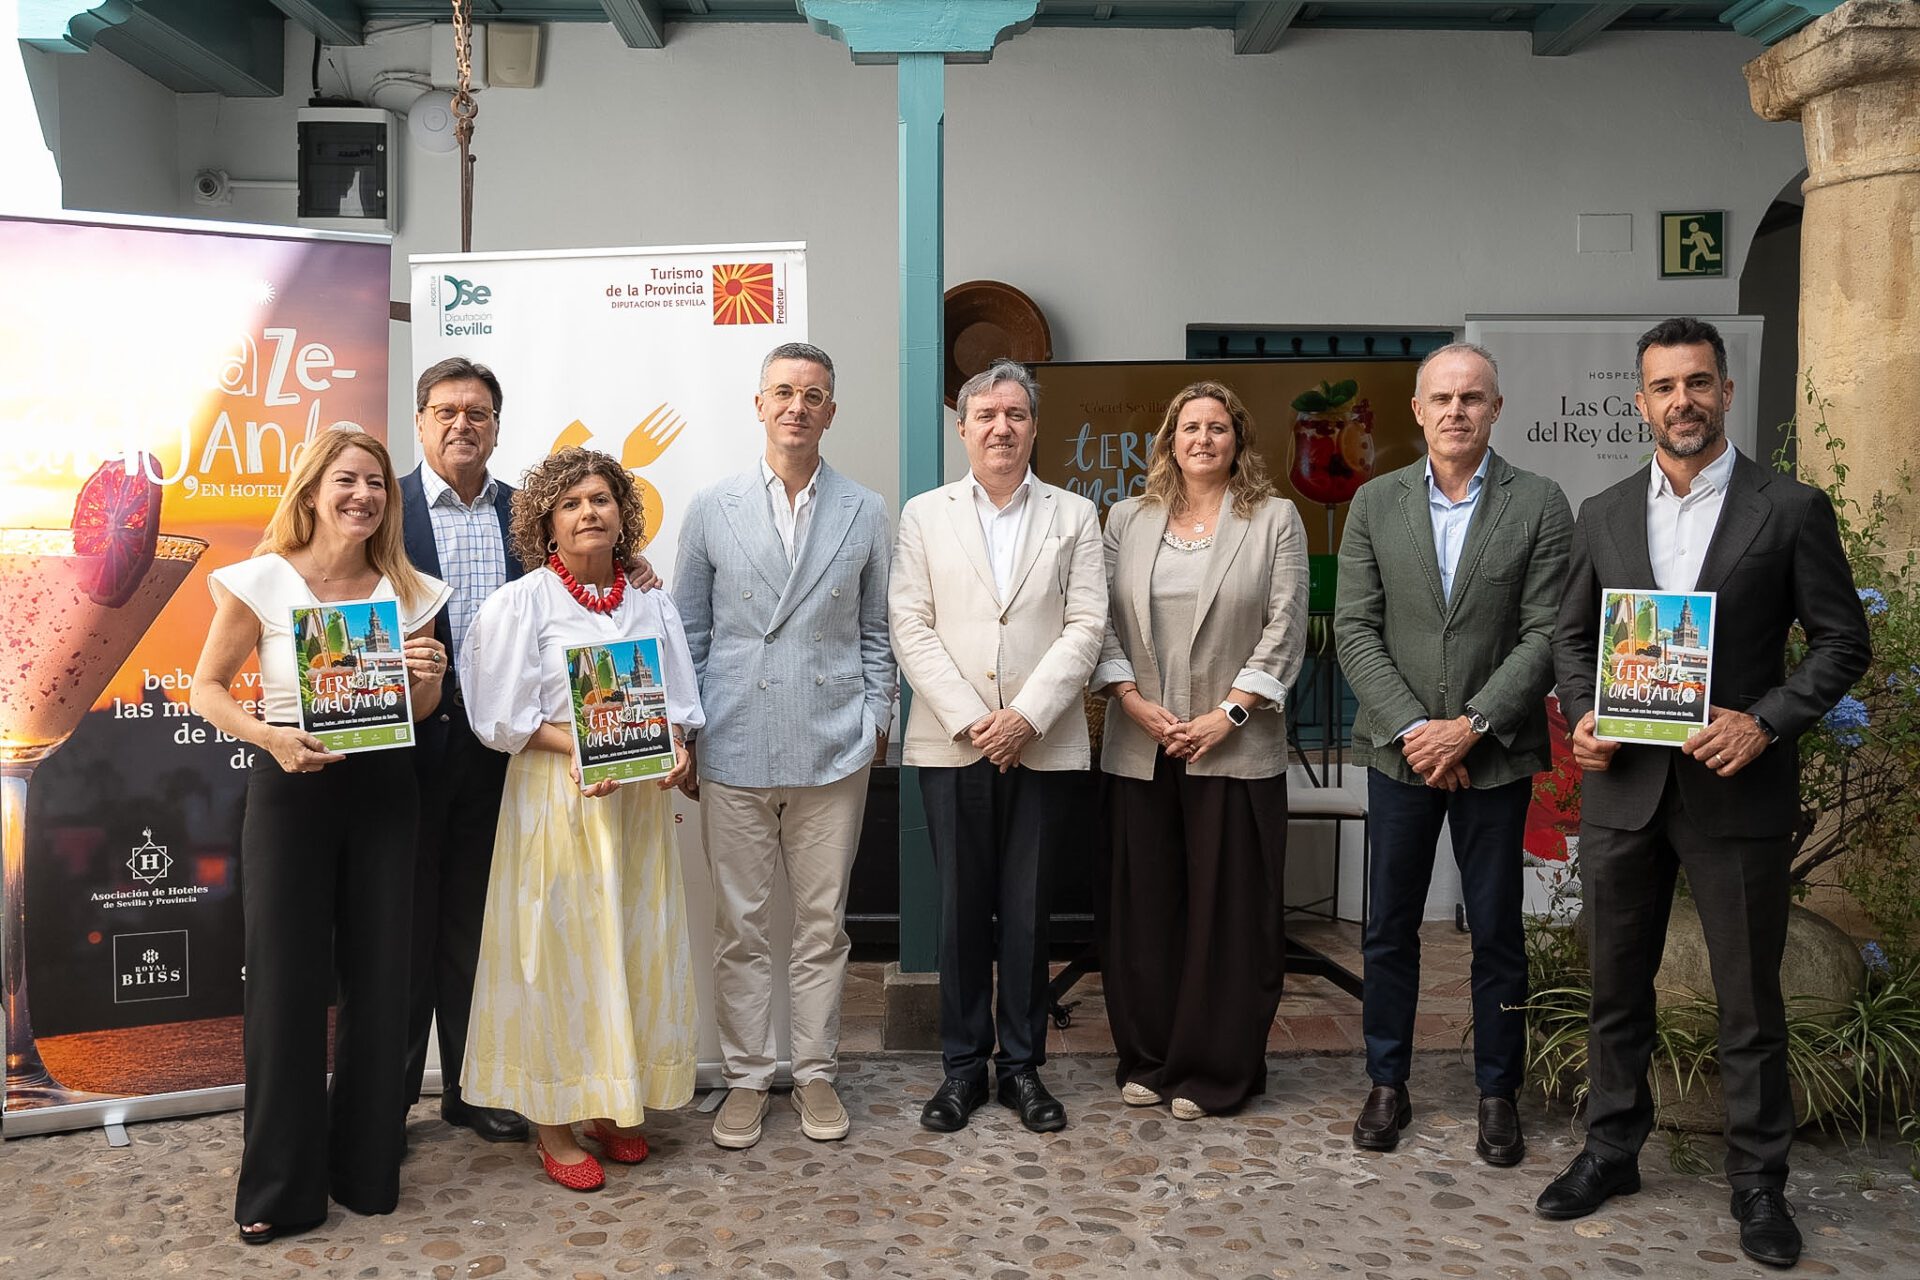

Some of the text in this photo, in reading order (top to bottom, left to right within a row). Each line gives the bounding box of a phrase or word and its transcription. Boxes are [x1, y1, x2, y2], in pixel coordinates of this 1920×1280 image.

[651, 267, 703, 280] Turismo
[606, 282, 704, 297] de la Provincia
[663, 300, 673, 308] DE
[675, 299, 706, 307] SEVILLA
[776, 287, 784, 324] Prodetur
[445, 322, 492, 336] Sevilla
[1561, 395, 1598, 417] Las
[1527, 421, 1557, 443] del
[1564, 422, 1601, 448] Rey
[1607, 421, 1632, 443] de
[201, 483, 286, 498] EN HOTEL
[142, 667, 193, 690] beb
[114, 698, 154, 719] las
[174, 722, 206, 744] de
[140, 853, 160, 870] H
[91, 885, 208, 901] Asociación de Hoteles
[103, 901, 114, 909] de
[116, 899, 146, 908] Sevilla
[156, 895, 197, 905] Provincia
[135, 964, 167, 973] ROYAL
[122, 969, 181, 986] BLISS
